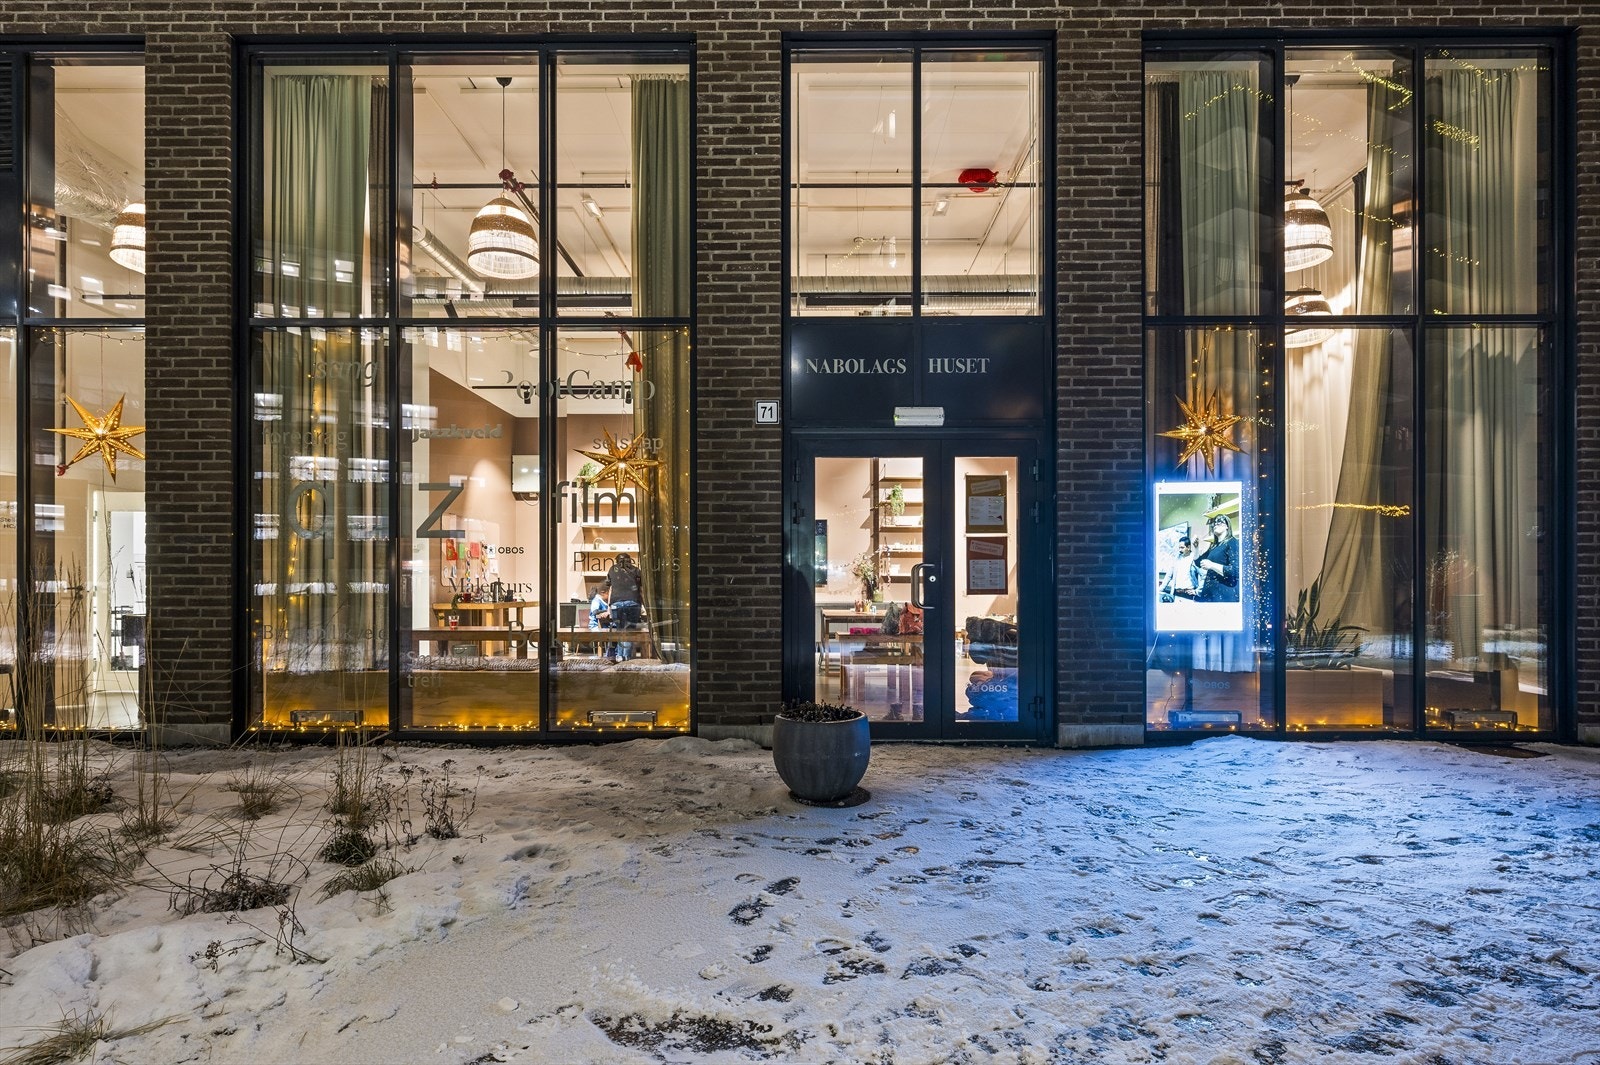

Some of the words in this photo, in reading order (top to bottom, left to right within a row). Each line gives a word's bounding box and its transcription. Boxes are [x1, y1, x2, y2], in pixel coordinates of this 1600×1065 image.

[314, 361, 379, 387] sang
[805, 358, 907, 374] NABOLAGS
[928, 358, 990, 373] HUSET
[760, 406, 774, 419] 71
[411, 424, 503, 443] jazzkveld
[551, 481, 635, 523] film
[497, 546, 525, 555] OBOS
[573, 551, 681, 573] Planeurs
[406, 672, 443, 688] treff
[1204, 681, 1231, 690] OBOS
[980, 684, 1008, 693] OBOS
